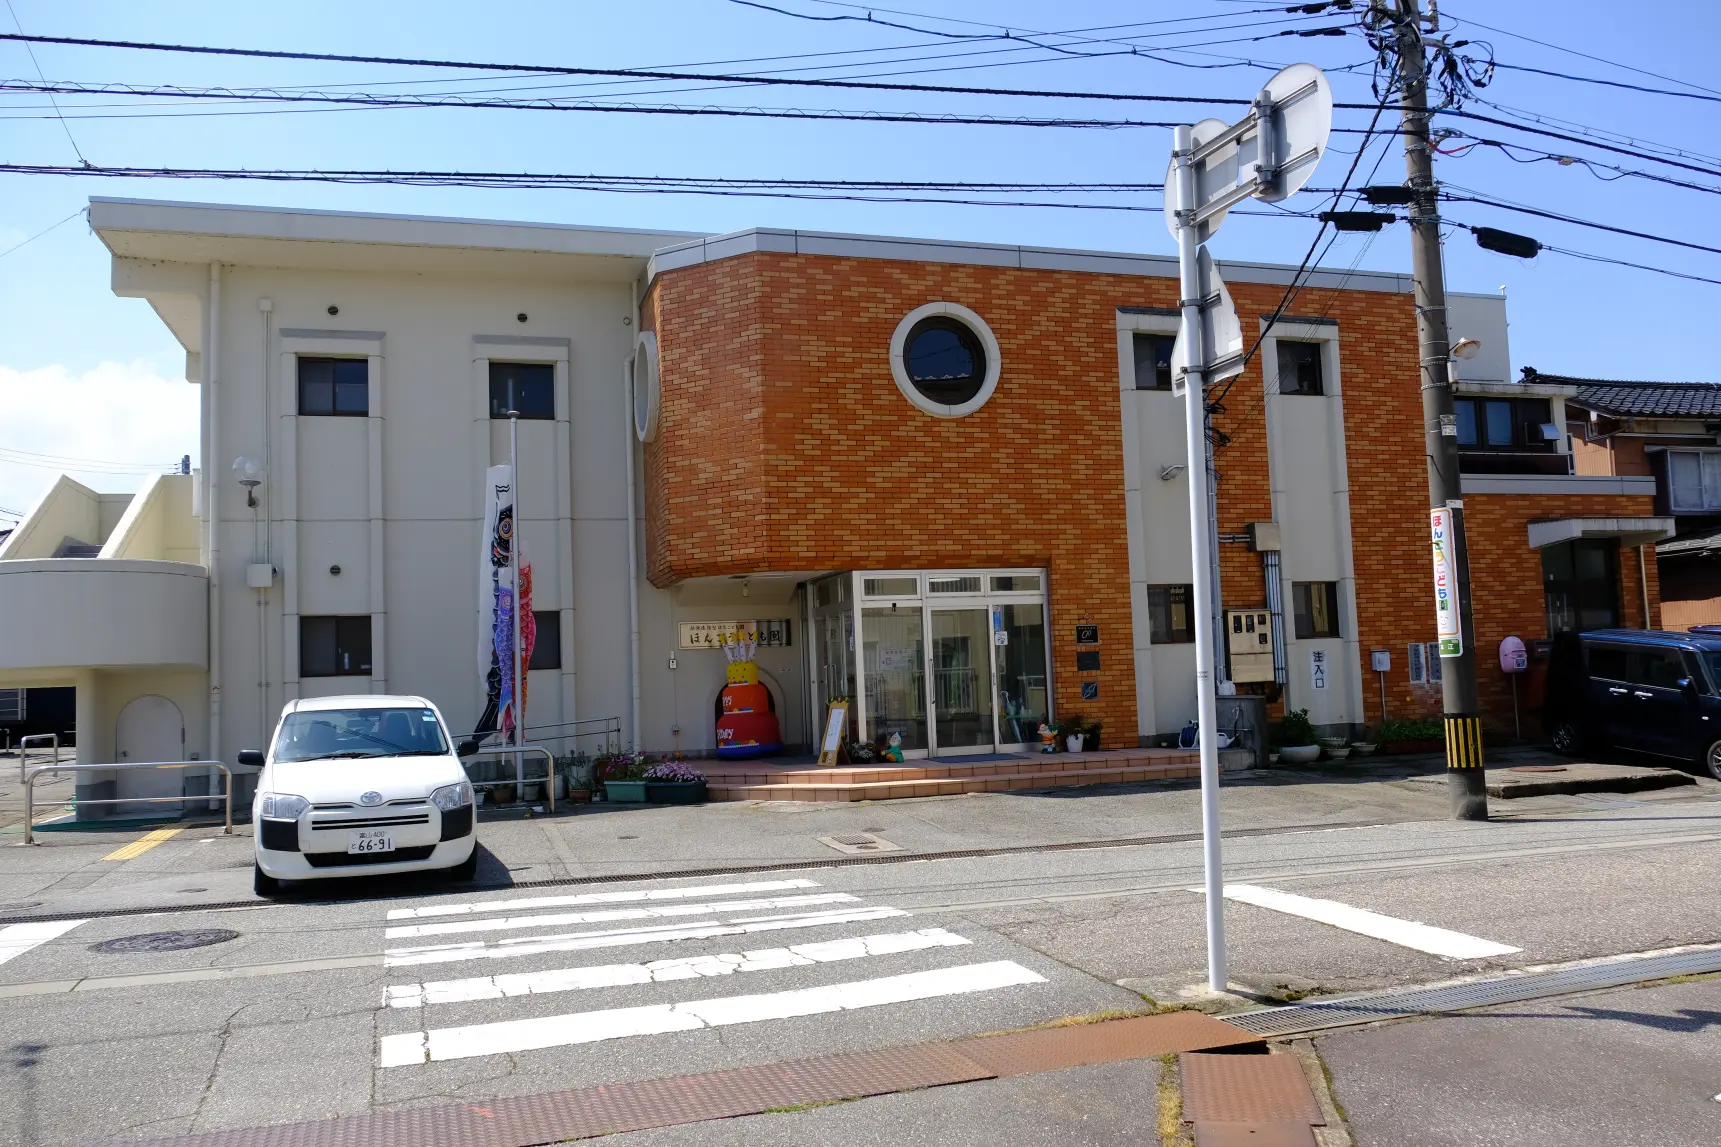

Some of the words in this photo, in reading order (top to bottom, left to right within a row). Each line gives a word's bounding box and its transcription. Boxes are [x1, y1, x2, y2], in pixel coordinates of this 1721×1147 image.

[1312, 651, 1325, 689] 注入口
[358, 838, 391, 851] 66-91
